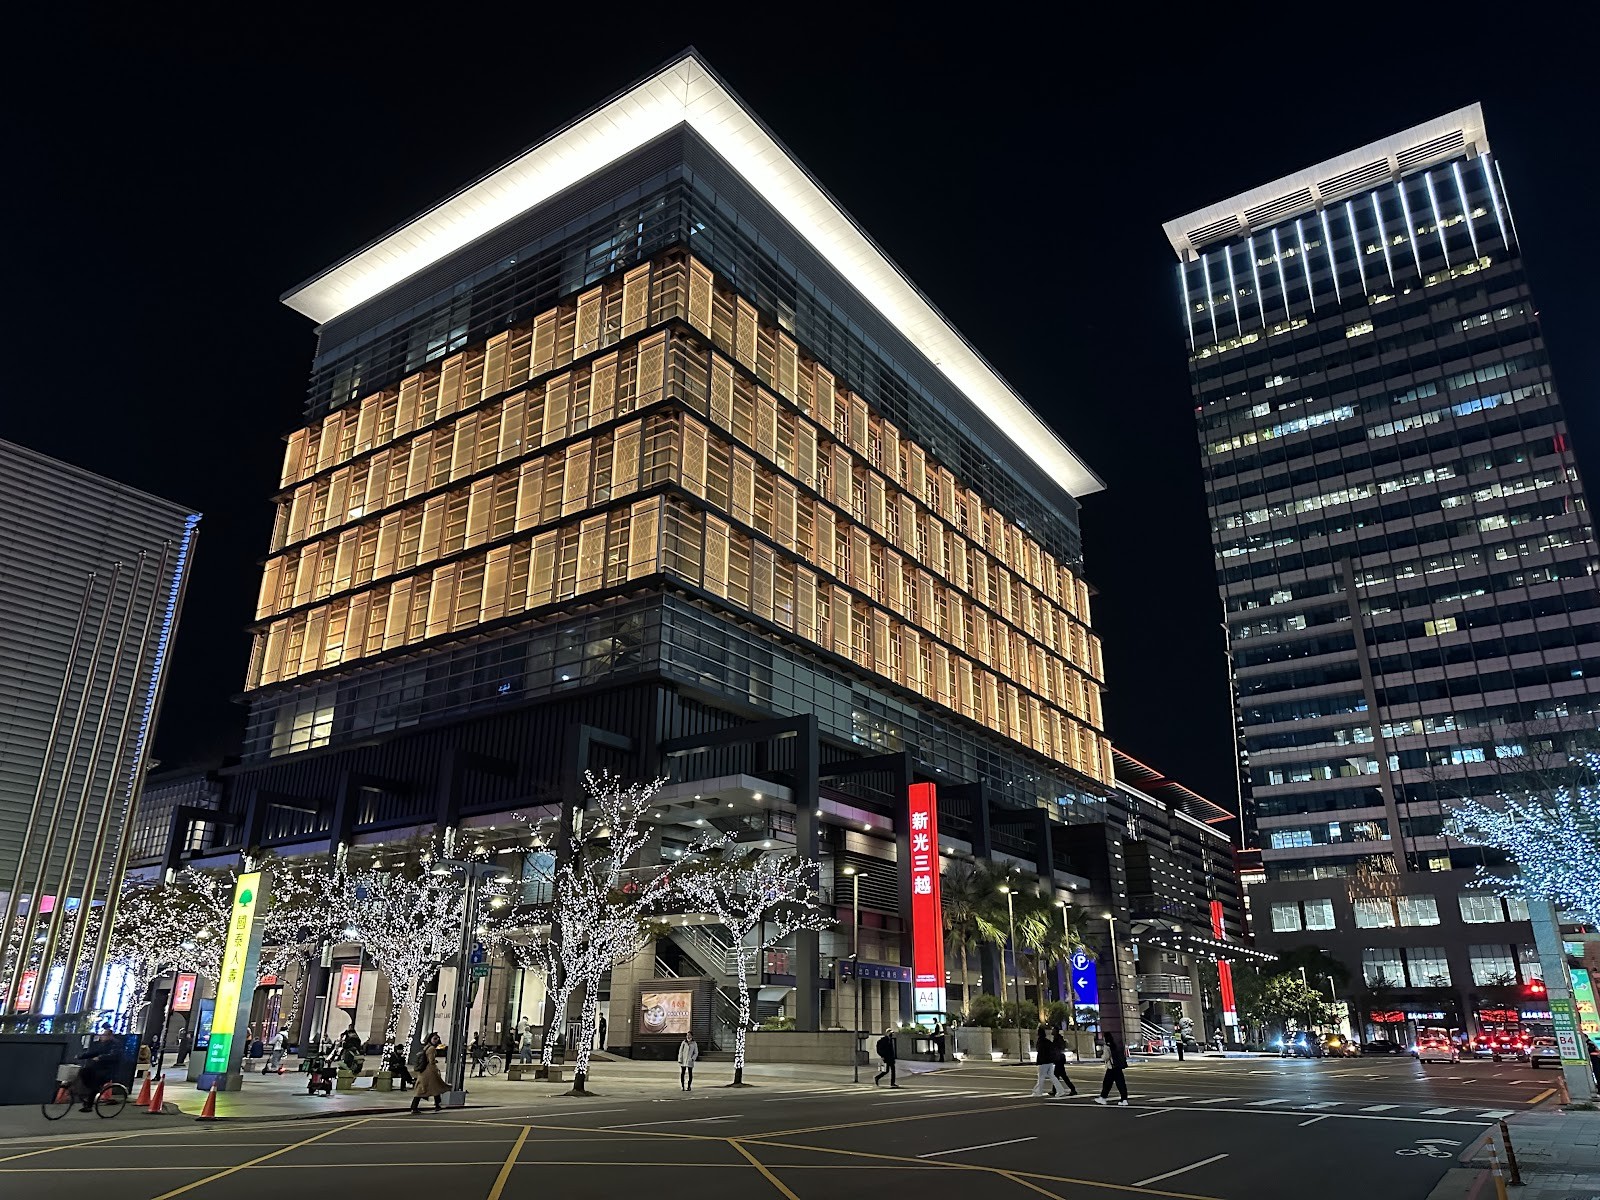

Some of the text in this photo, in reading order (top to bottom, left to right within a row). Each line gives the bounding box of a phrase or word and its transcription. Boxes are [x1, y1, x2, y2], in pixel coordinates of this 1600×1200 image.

[911, 811, 931, 895] 新光三越
[228, 914, 247, 983] 國泰人壽
[919, 991, 934, 1003] A4
[1559, 1036, 1574, 1045] B4
